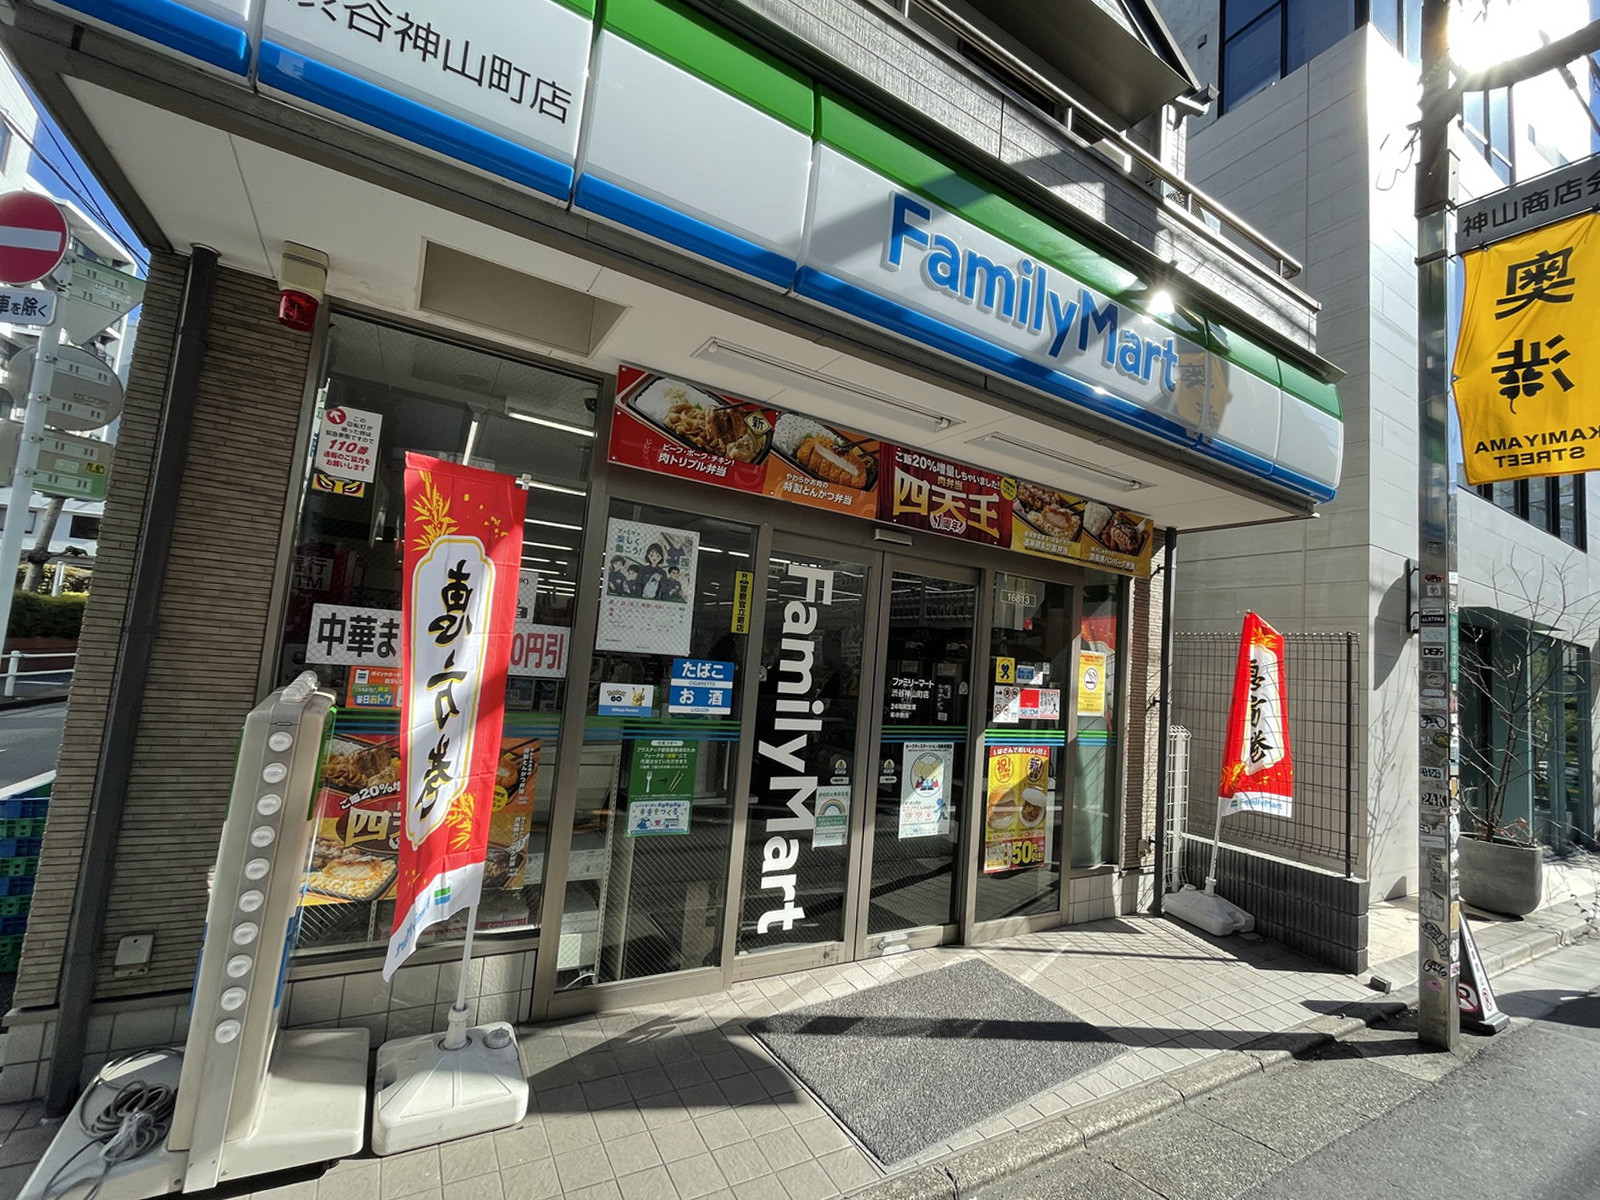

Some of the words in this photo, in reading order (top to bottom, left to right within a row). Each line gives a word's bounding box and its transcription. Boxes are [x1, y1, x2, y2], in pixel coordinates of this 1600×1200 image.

[884, 191, 1180, 393] FamilyMart
[751, 416, 764, 430] 新
[329, 439, 369, 455] 110番
[326, 459, 367, 472] お願いします
[658, 452, 727, 478] 肉トリプル弁当
[937, 476, 963, 490] 肉弁当
[784, 482, 853, 506] 特製とんかつ弁当
[893, 465, 1000, 539] 四天王
[936, 513, 961, 533] 1周年
[317, 612, 401, 658] 中華ま
[510, 632, 565, 670] 0円引
[681, 661, 724, 679] たばこ
[892, 677, 935, 688] ファミリーマート
[356, 695, 392, 705] 毎日おトク
[679, 688, 724, 706] お酒
[757, 565, 834, 934] FamilyMart
[1240, 798, 1284, 810] FamilyMart
[1422, 793, 1445, 807] 24K
